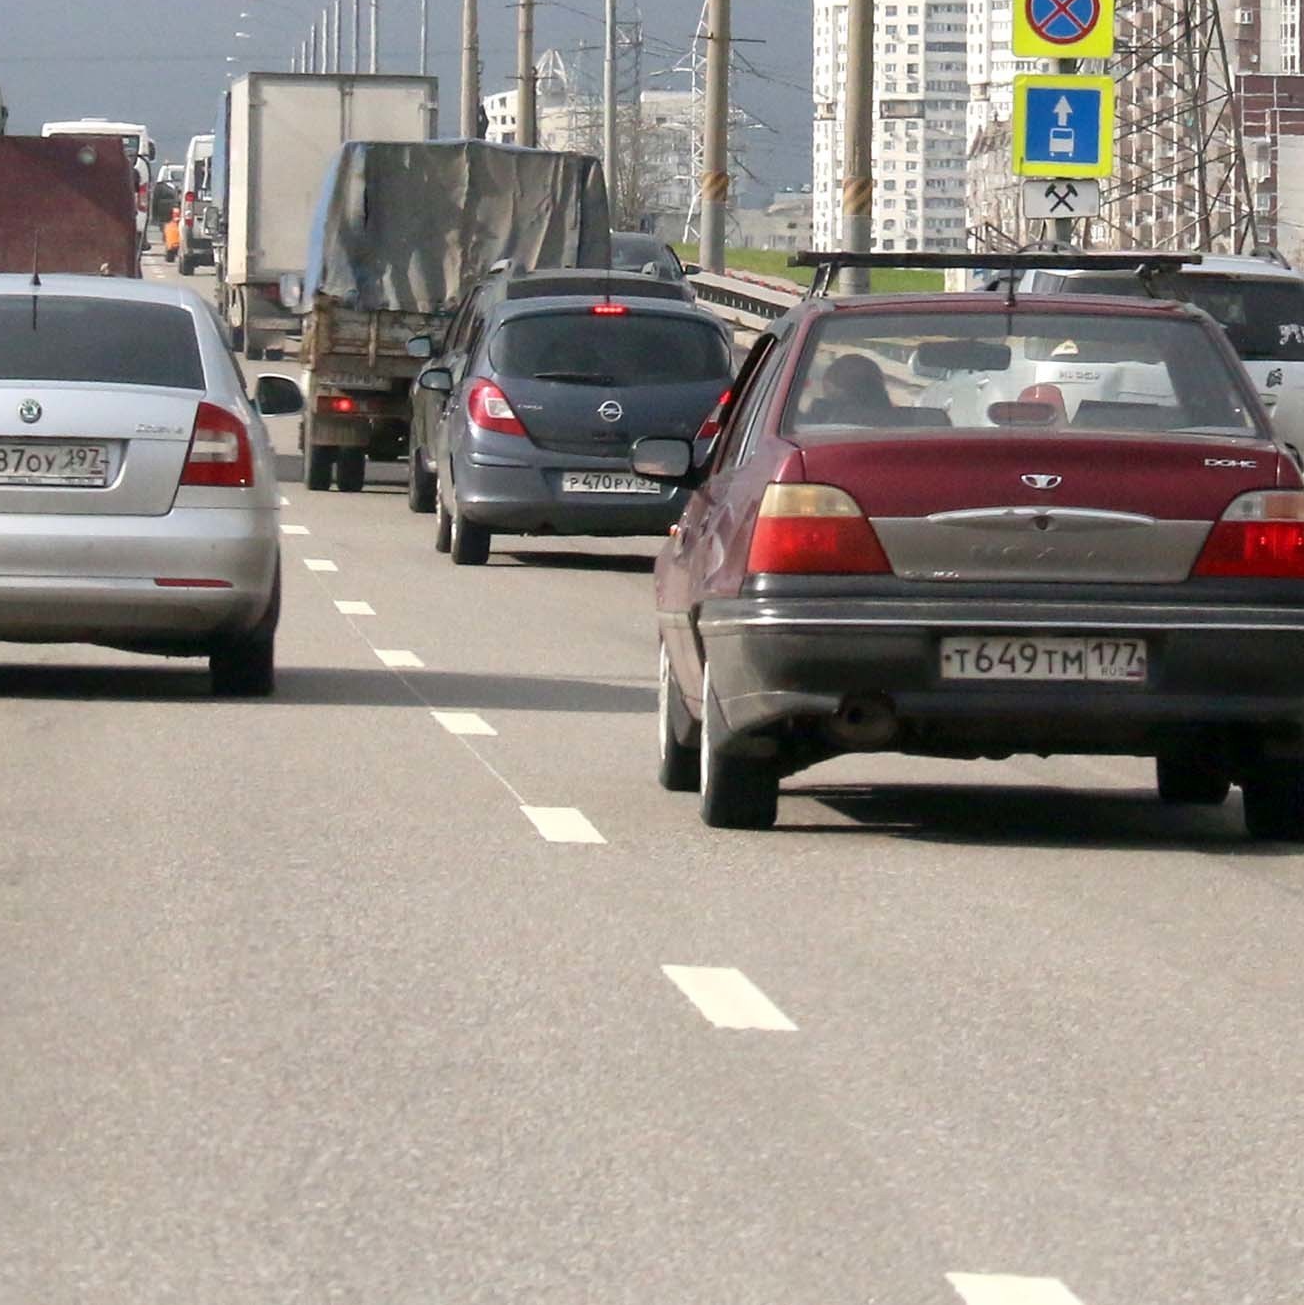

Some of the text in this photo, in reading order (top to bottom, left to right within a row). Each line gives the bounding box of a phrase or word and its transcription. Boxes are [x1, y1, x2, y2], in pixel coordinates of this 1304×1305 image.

[1205, 458, 1256, 469] DOHC
[955, 642, 1138, 674] Т649ТМ 177
